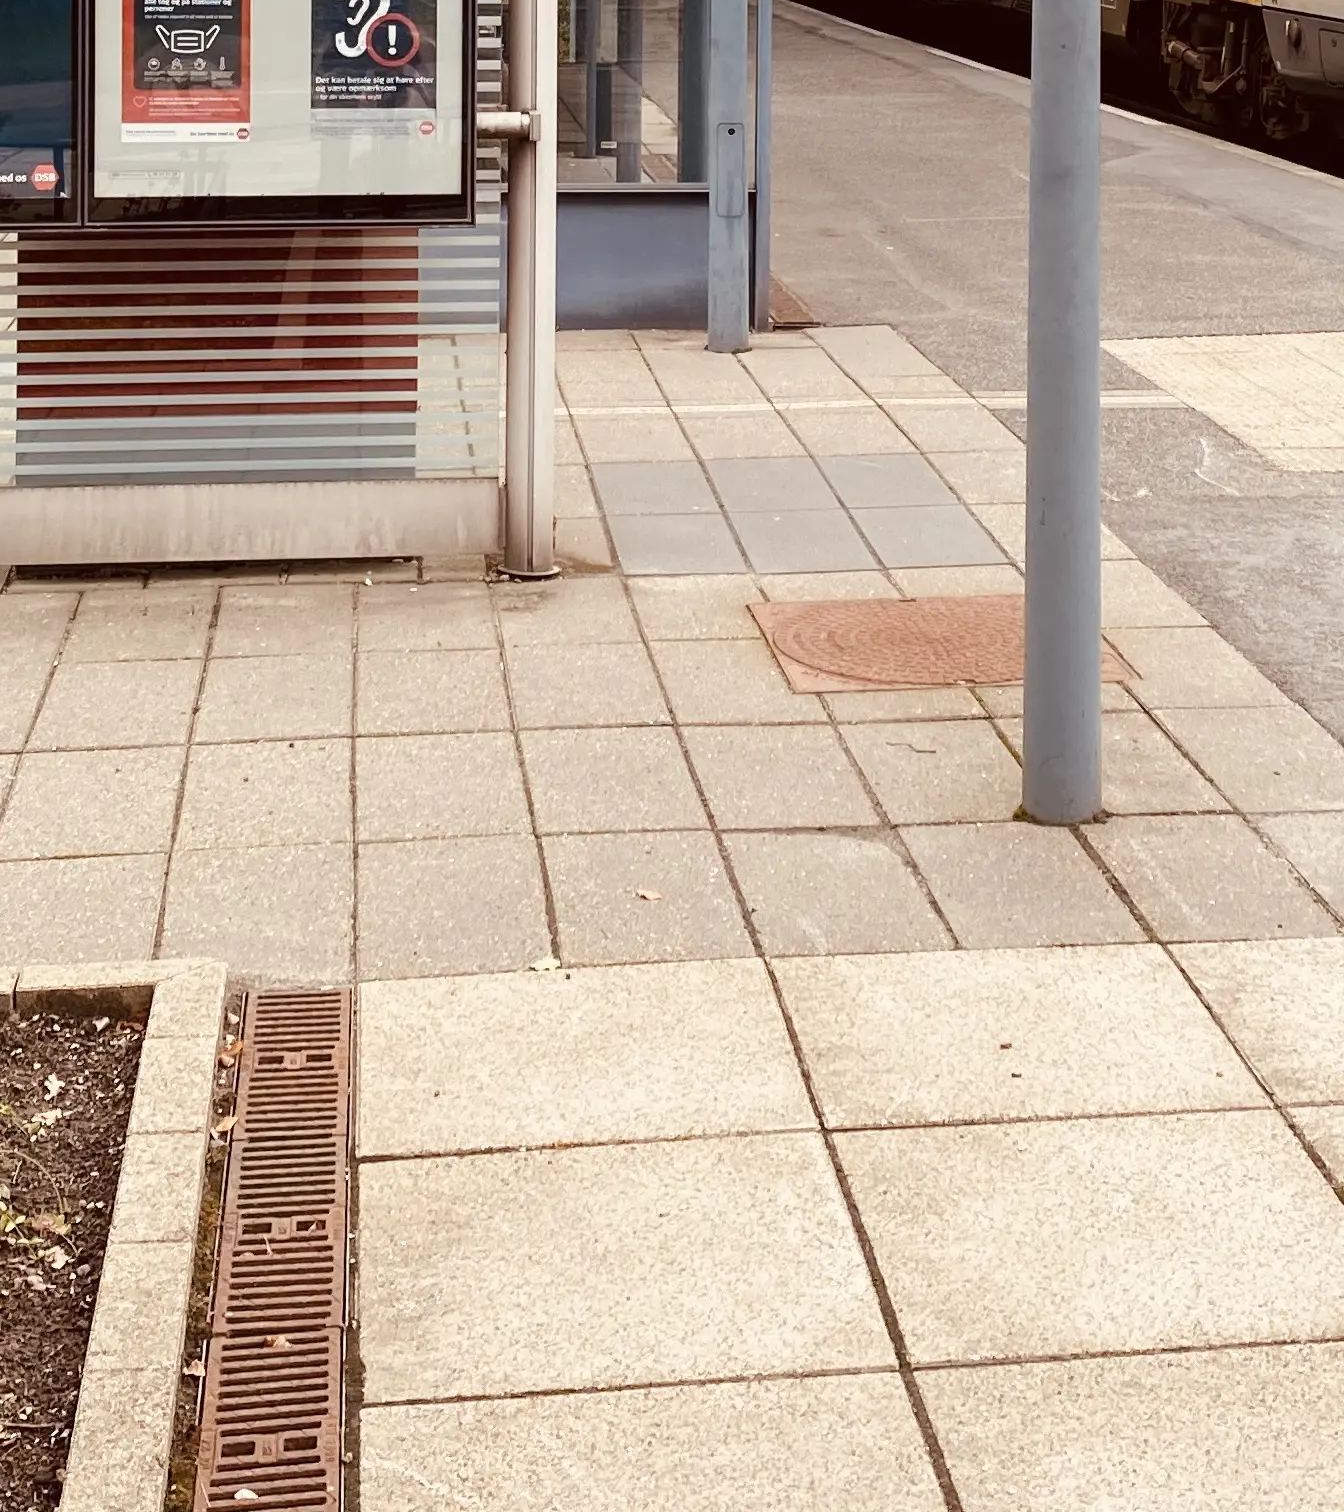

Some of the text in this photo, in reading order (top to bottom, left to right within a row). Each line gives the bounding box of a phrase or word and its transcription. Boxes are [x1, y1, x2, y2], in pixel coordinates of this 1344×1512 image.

[373, 76, 385, 85] sig
[415, 76, 435, 84] efter
[15, 174, 27, 182] os
[34, 173, 56, 182] DSB
